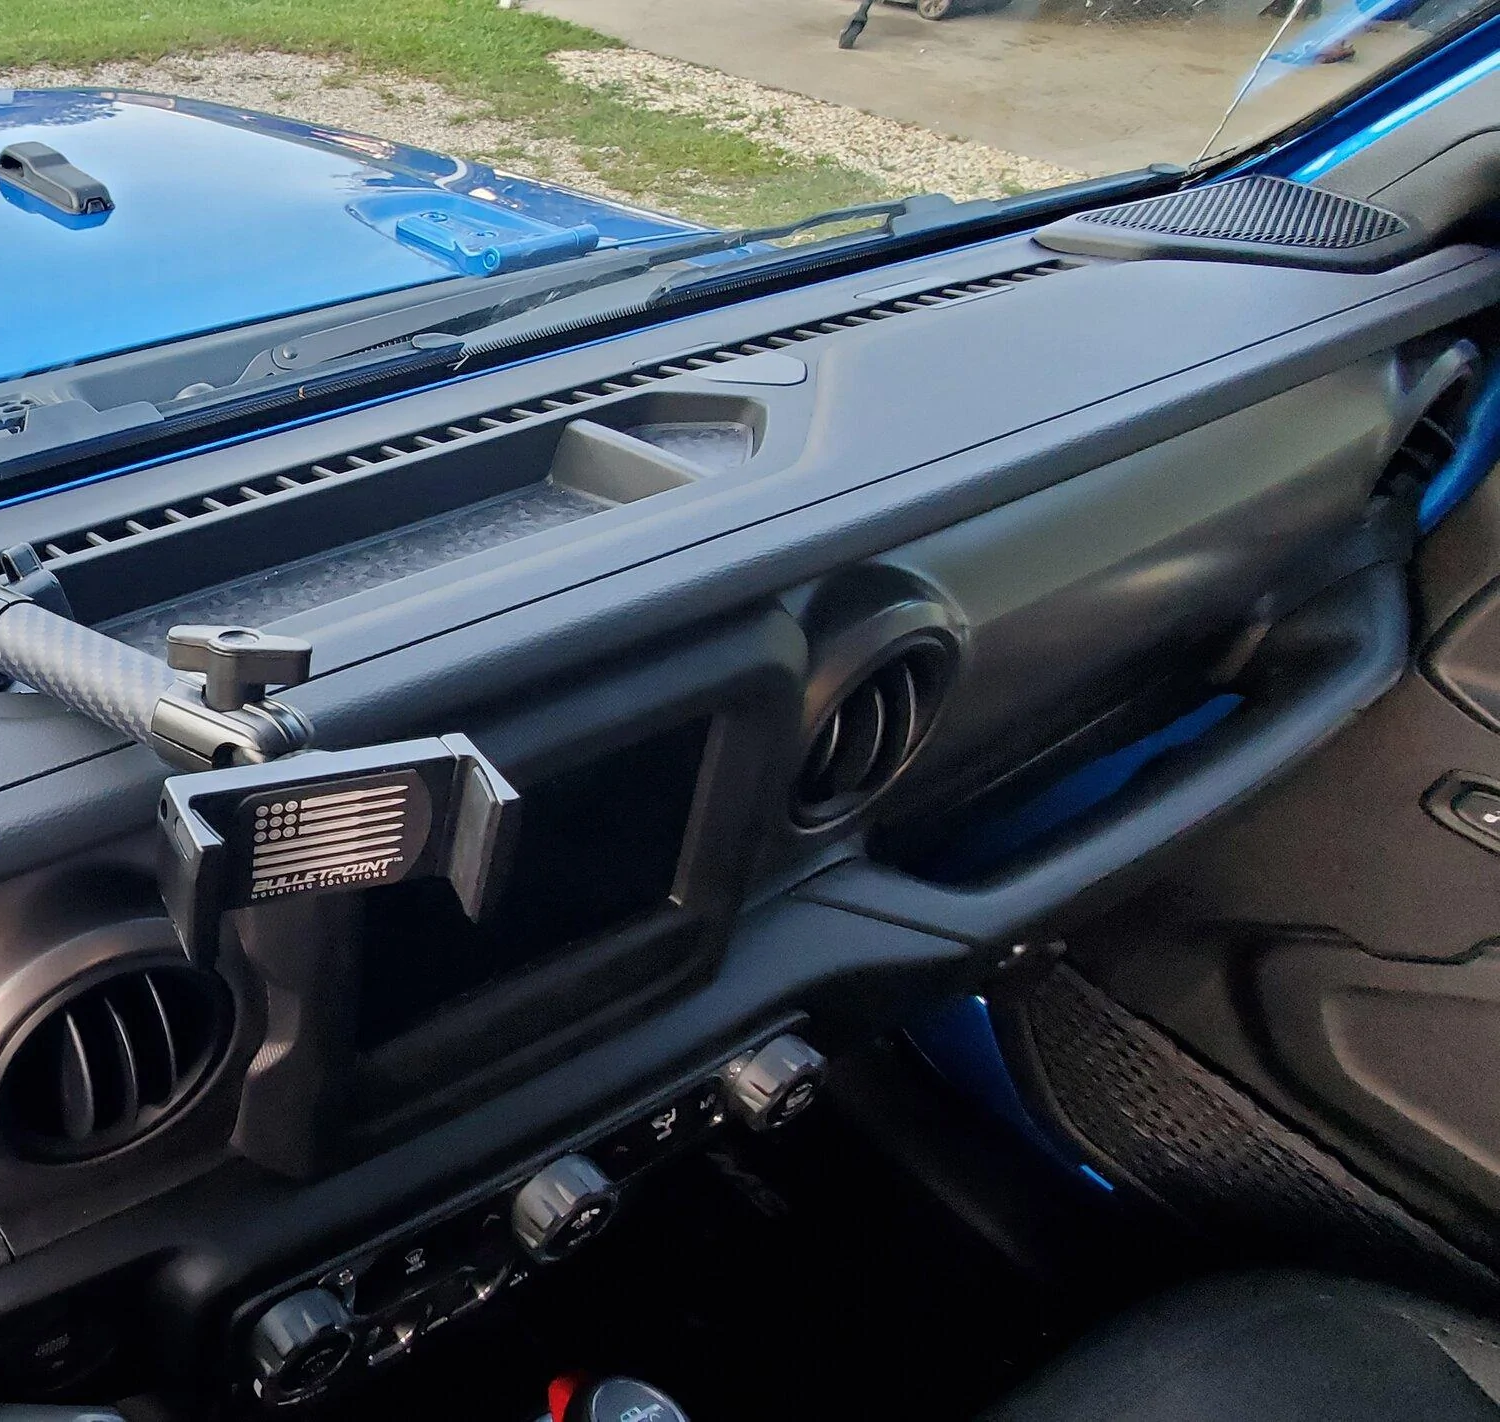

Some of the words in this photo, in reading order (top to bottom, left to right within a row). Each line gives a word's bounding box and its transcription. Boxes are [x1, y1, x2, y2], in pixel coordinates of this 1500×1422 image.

[250, 882, 313, 900] MOUNTING
[320, 870, 388, 888] SOLUTIONS
[252, 858, 394, 893] BULLETPOINT
